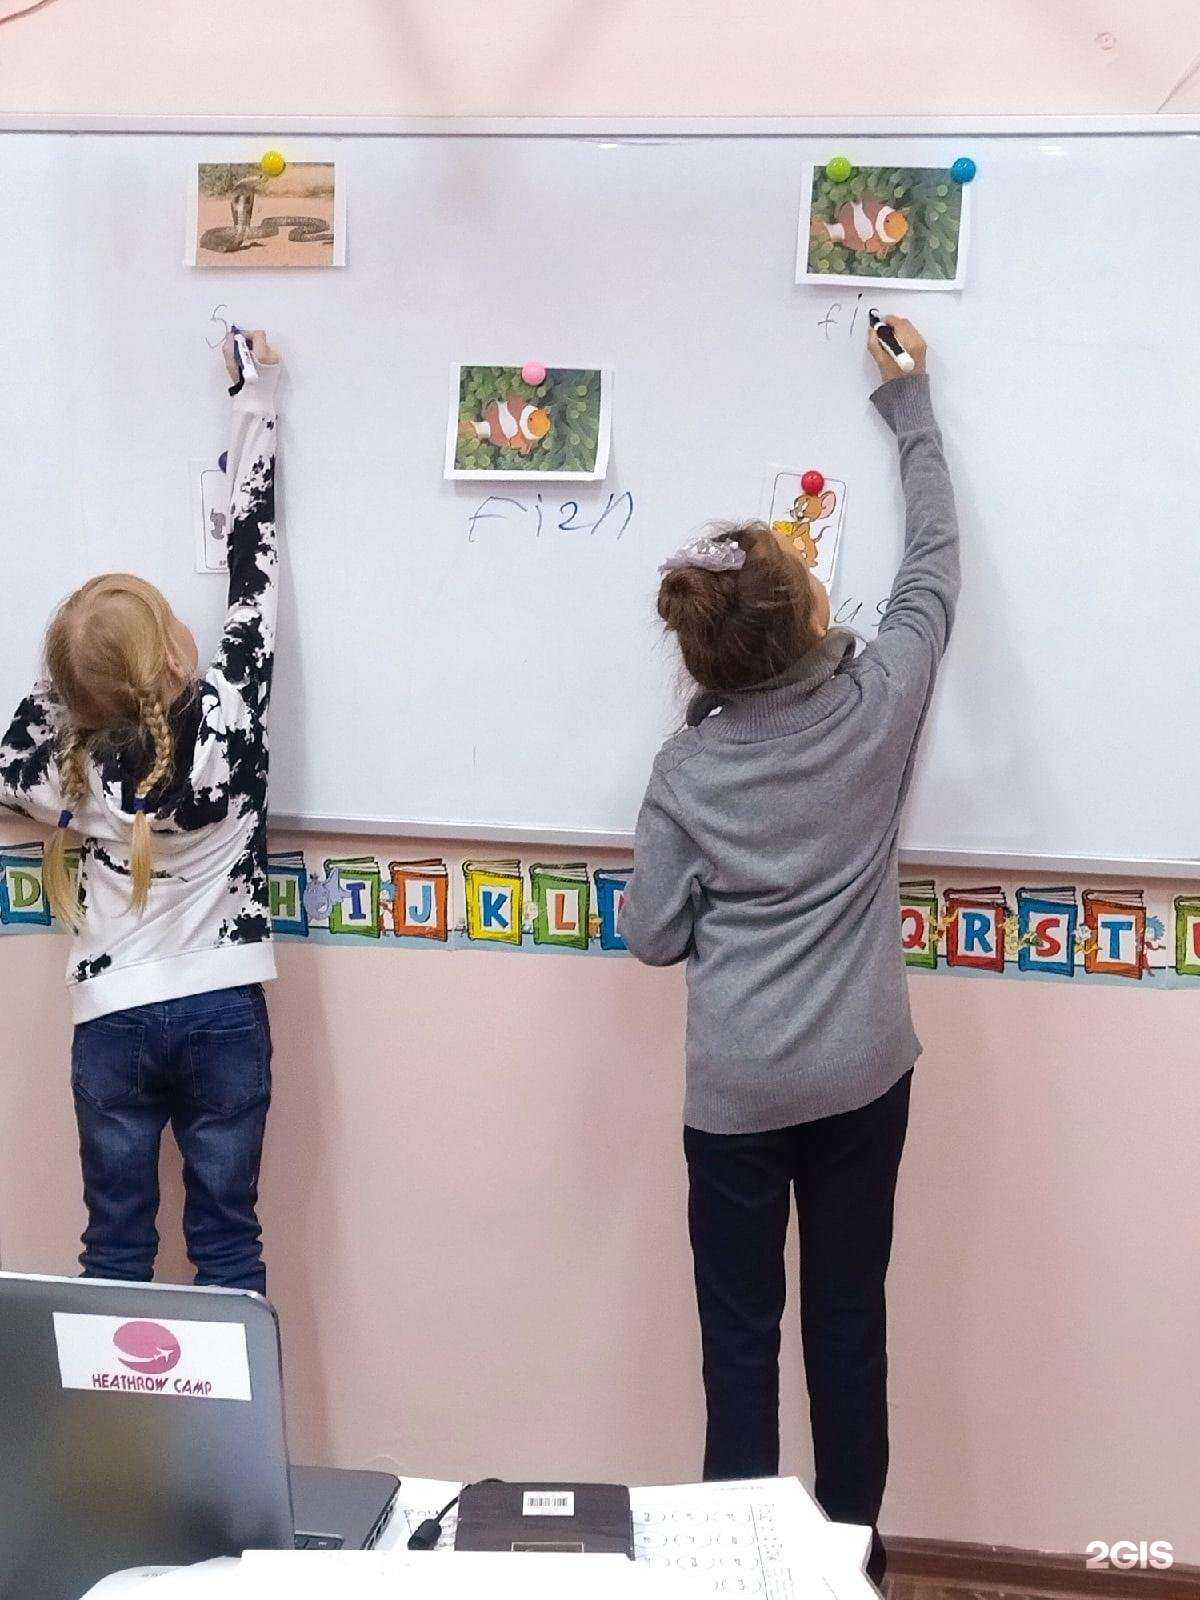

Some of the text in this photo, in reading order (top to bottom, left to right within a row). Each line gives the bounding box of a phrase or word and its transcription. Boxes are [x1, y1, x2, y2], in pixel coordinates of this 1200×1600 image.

[8, 871, 41, 908] D
[269, 879, 296, 917] H
[345, 882, 367, 920] I
[408, 885, 432, 923] J
[482, 891, 509, 929] K
[554, 893, 576, 930] L
[901, 908, 926, 950] Q
[962, 912, 994, 953] R
[1035, 917, 1060, 957] S
[1101, 921, 1132, 959] T
[92, 1373, 212, 1395] HEATHROW CAMP
